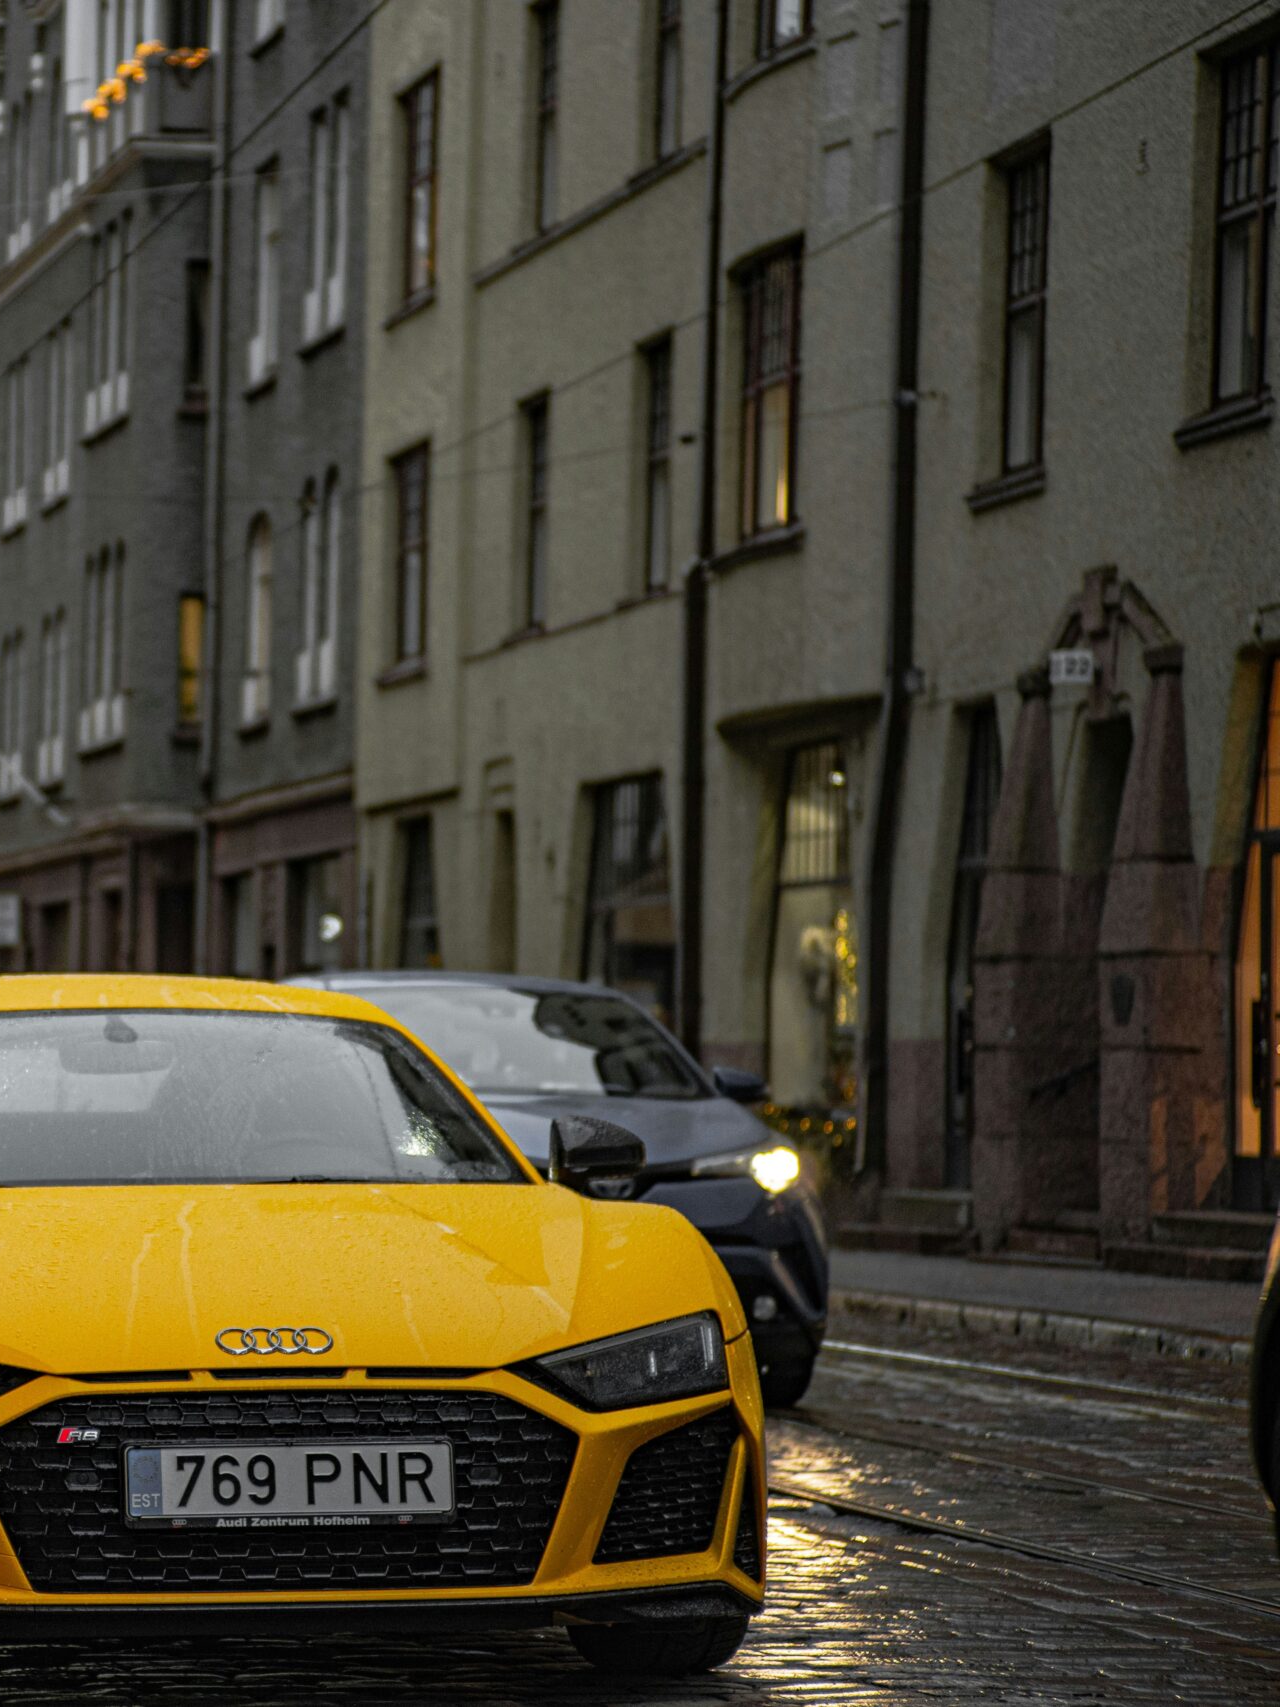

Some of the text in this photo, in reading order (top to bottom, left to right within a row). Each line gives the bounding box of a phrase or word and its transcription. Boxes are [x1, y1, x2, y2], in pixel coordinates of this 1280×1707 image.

[175, 1451, 437, 1508] 769 PNR
[131, 1492, 161, 1509] EST
[216, 1516, 371, 1528] Audi Zentrum Hofheim
